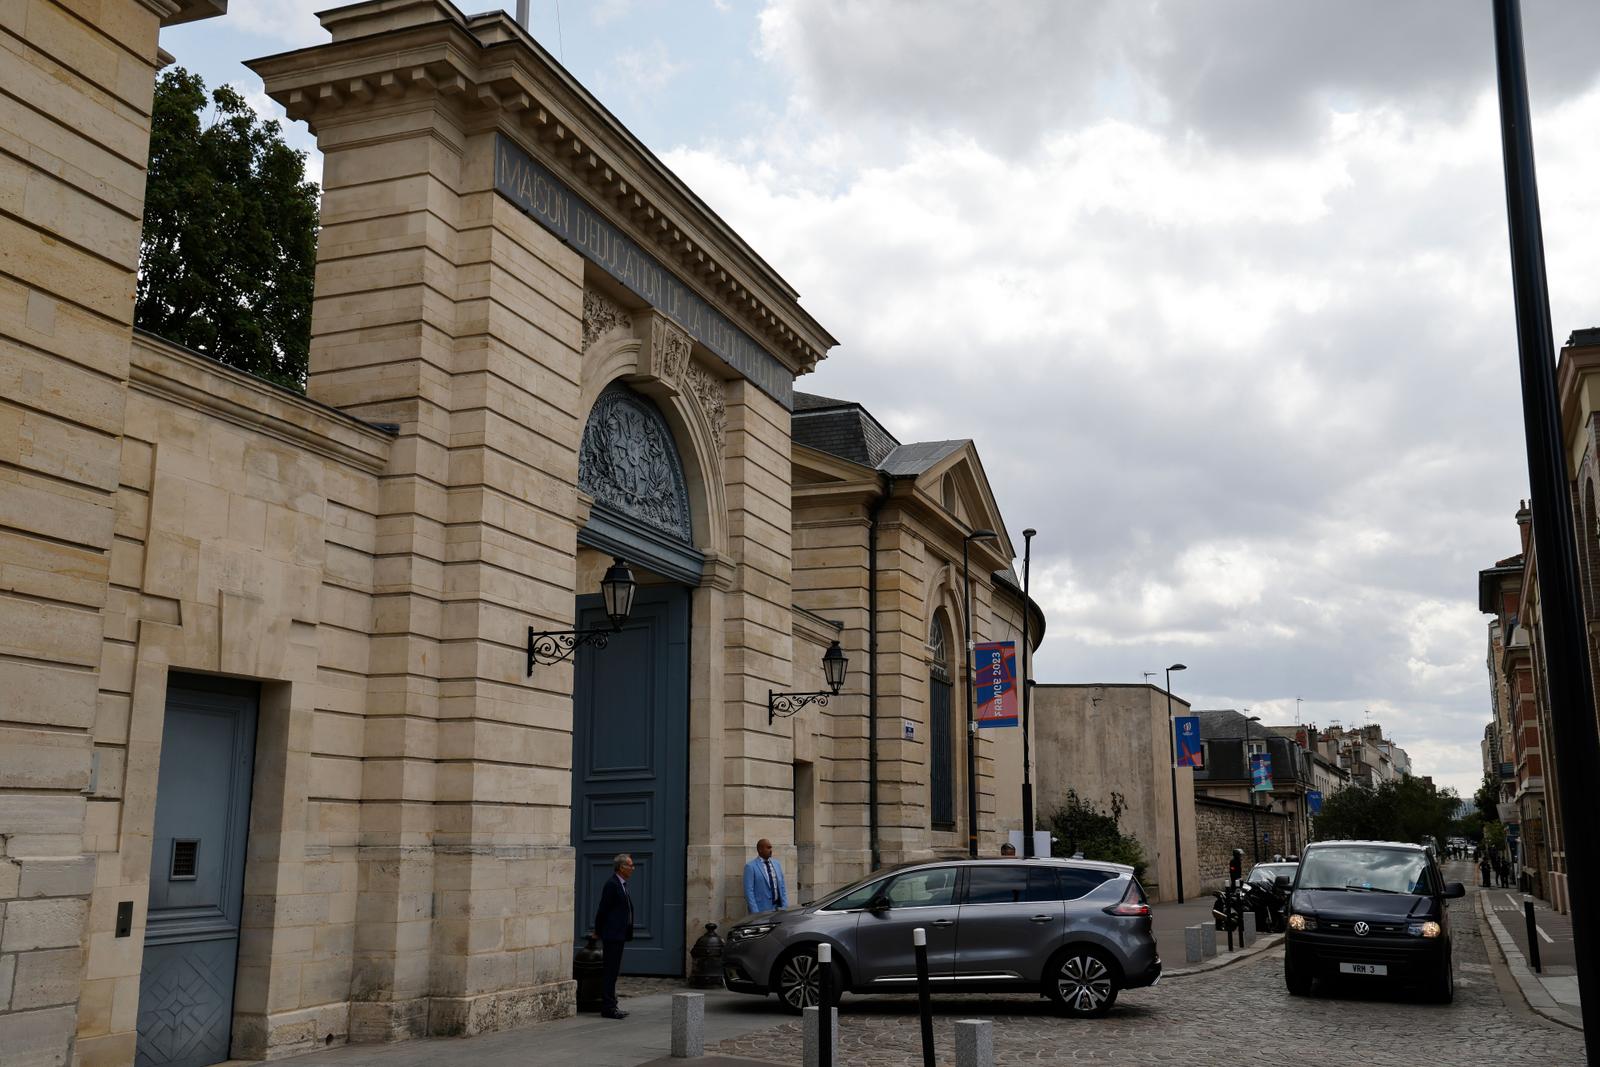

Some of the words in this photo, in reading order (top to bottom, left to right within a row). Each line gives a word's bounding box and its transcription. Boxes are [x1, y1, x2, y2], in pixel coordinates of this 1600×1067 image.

[501, 150, 569, 233] MAISON
[667, 279, 684, 320] DE
[992, 651, 1002, 676] 2023
[1369, 965, 1375, 974] 3
